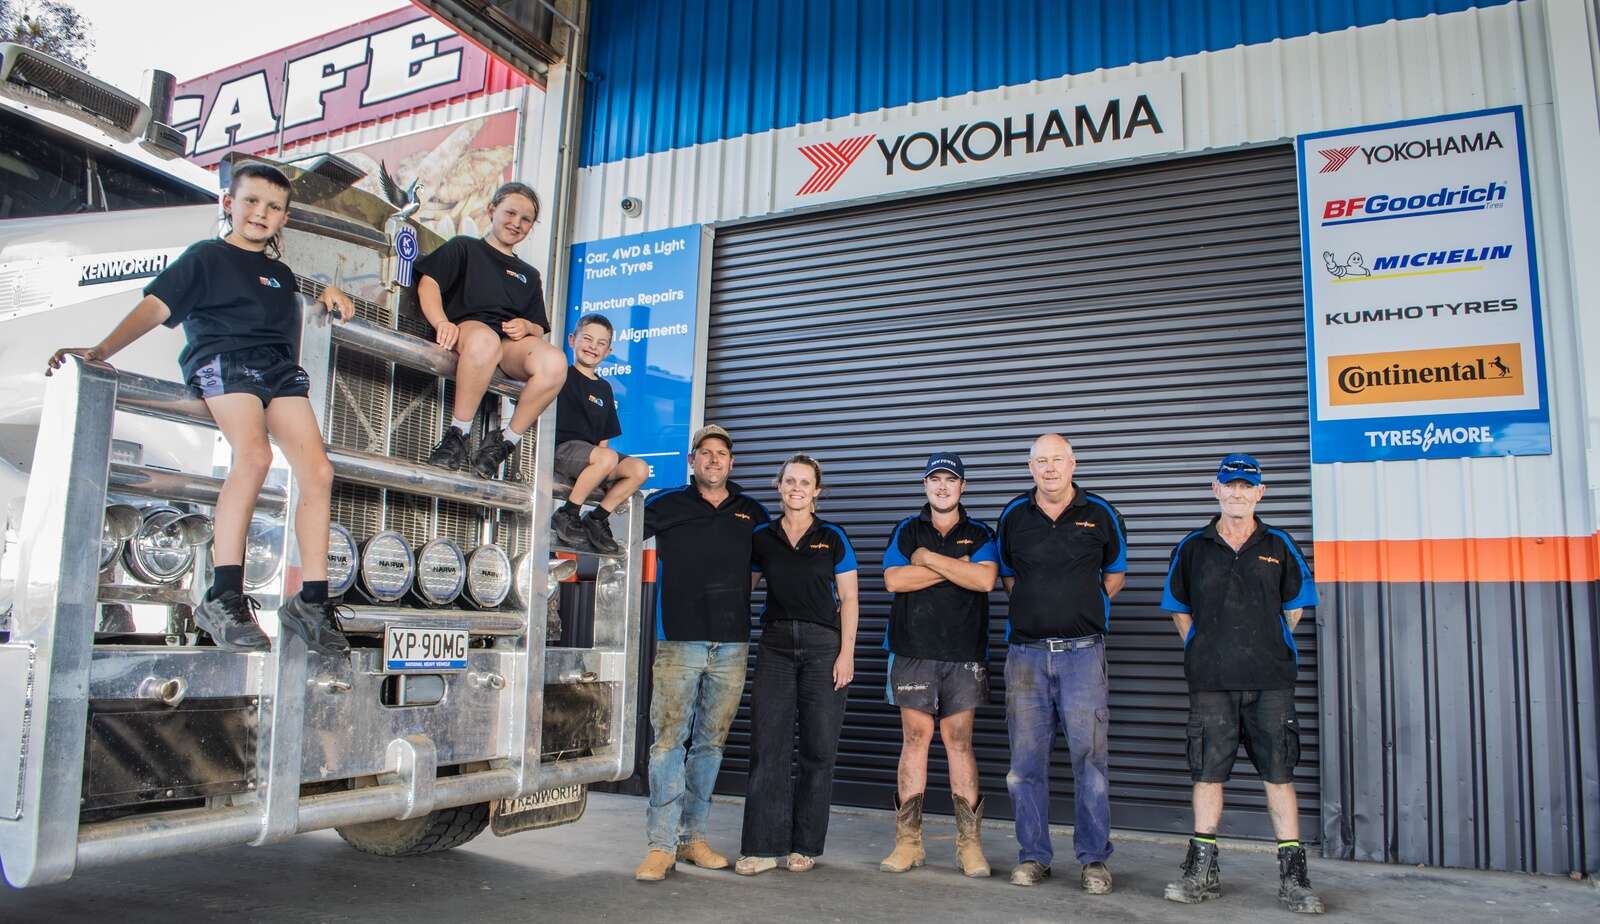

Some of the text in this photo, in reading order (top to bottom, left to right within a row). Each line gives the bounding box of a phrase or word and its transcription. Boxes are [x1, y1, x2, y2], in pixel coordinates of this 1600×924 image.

[876, 94, 1164, 176] YOKOHAMA
[1361, 131, 1504, 165] YOKOHAMA
[1323, 181, 1507, 219] BFGoodrich
[585, 239, 686, 264] Car, 4WD & Light
[1373, 245, 1513, 271] MICHELIN
[80, 254, 168, 281] KENWORTH
[585, 261, 653, 280] Truck Tyres
[582, 289, 684, 312] Puncture Repairs
[1325, 298, 1518, 326] KUMHO TYRES
[618, 323, 688, 343] Alignments
[595, 363, 632, 377] teries
[1337, 358, 1487, 394] Continental
[1364, 422, 1493, 452] TYRES&MORE
[378, 560, 404, 569] NARVA
